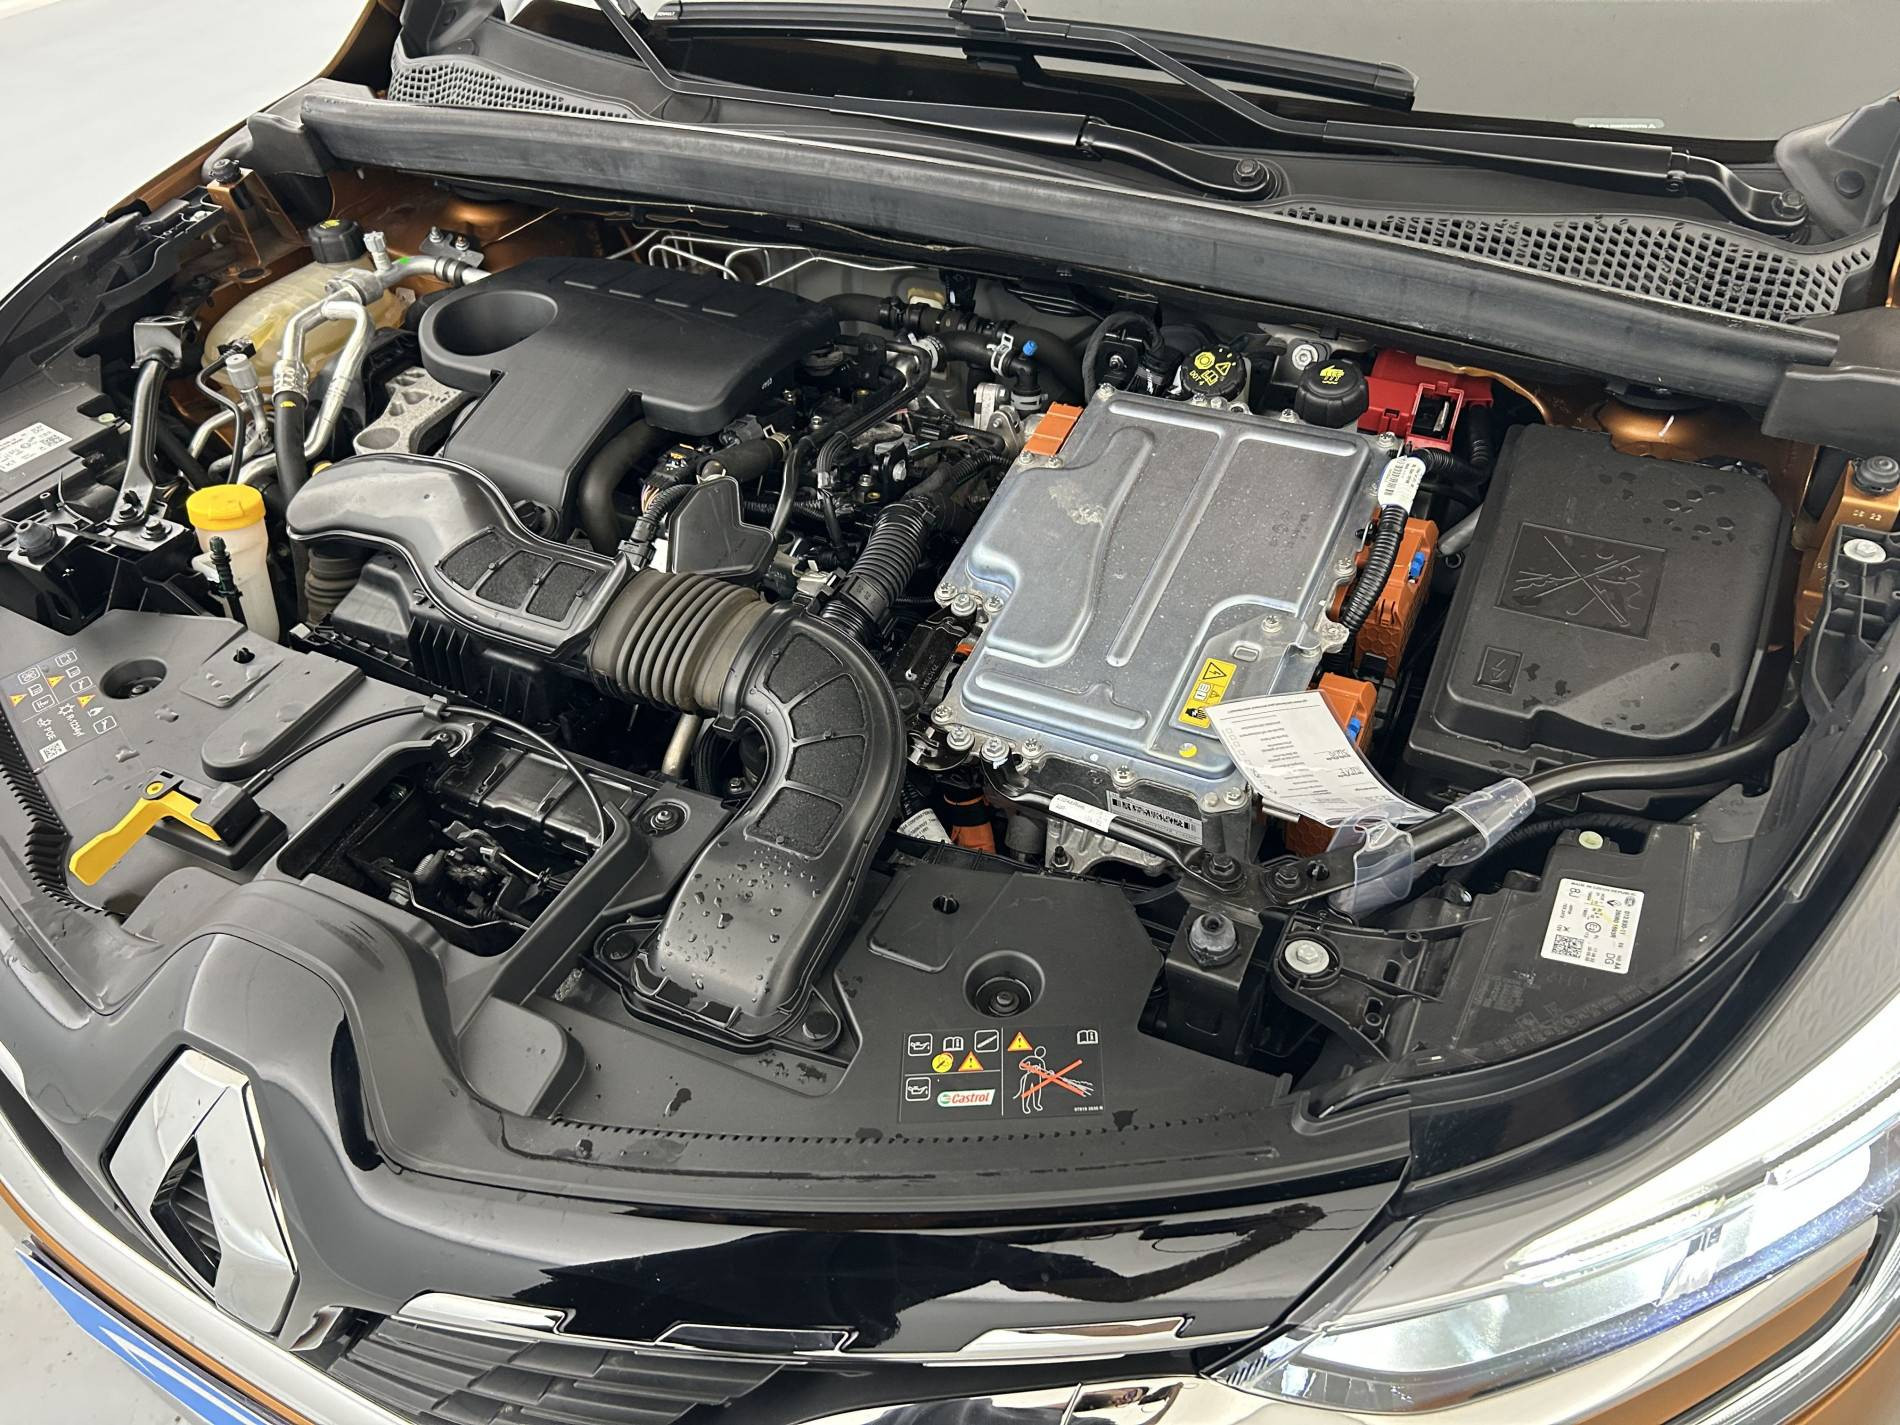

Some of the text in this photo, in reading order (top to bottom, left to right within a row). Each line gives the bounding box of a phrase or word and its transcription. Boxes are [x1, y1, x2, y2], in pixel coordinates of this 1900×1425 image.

[1190, 370, 1201, 381] DOT
[44, 726, 56, 740] POE
[1568, 887, 1580, 898] 8J
[1604, 952, 1615, 965] DG
[952, 1092, 990, 1105] Castrol
